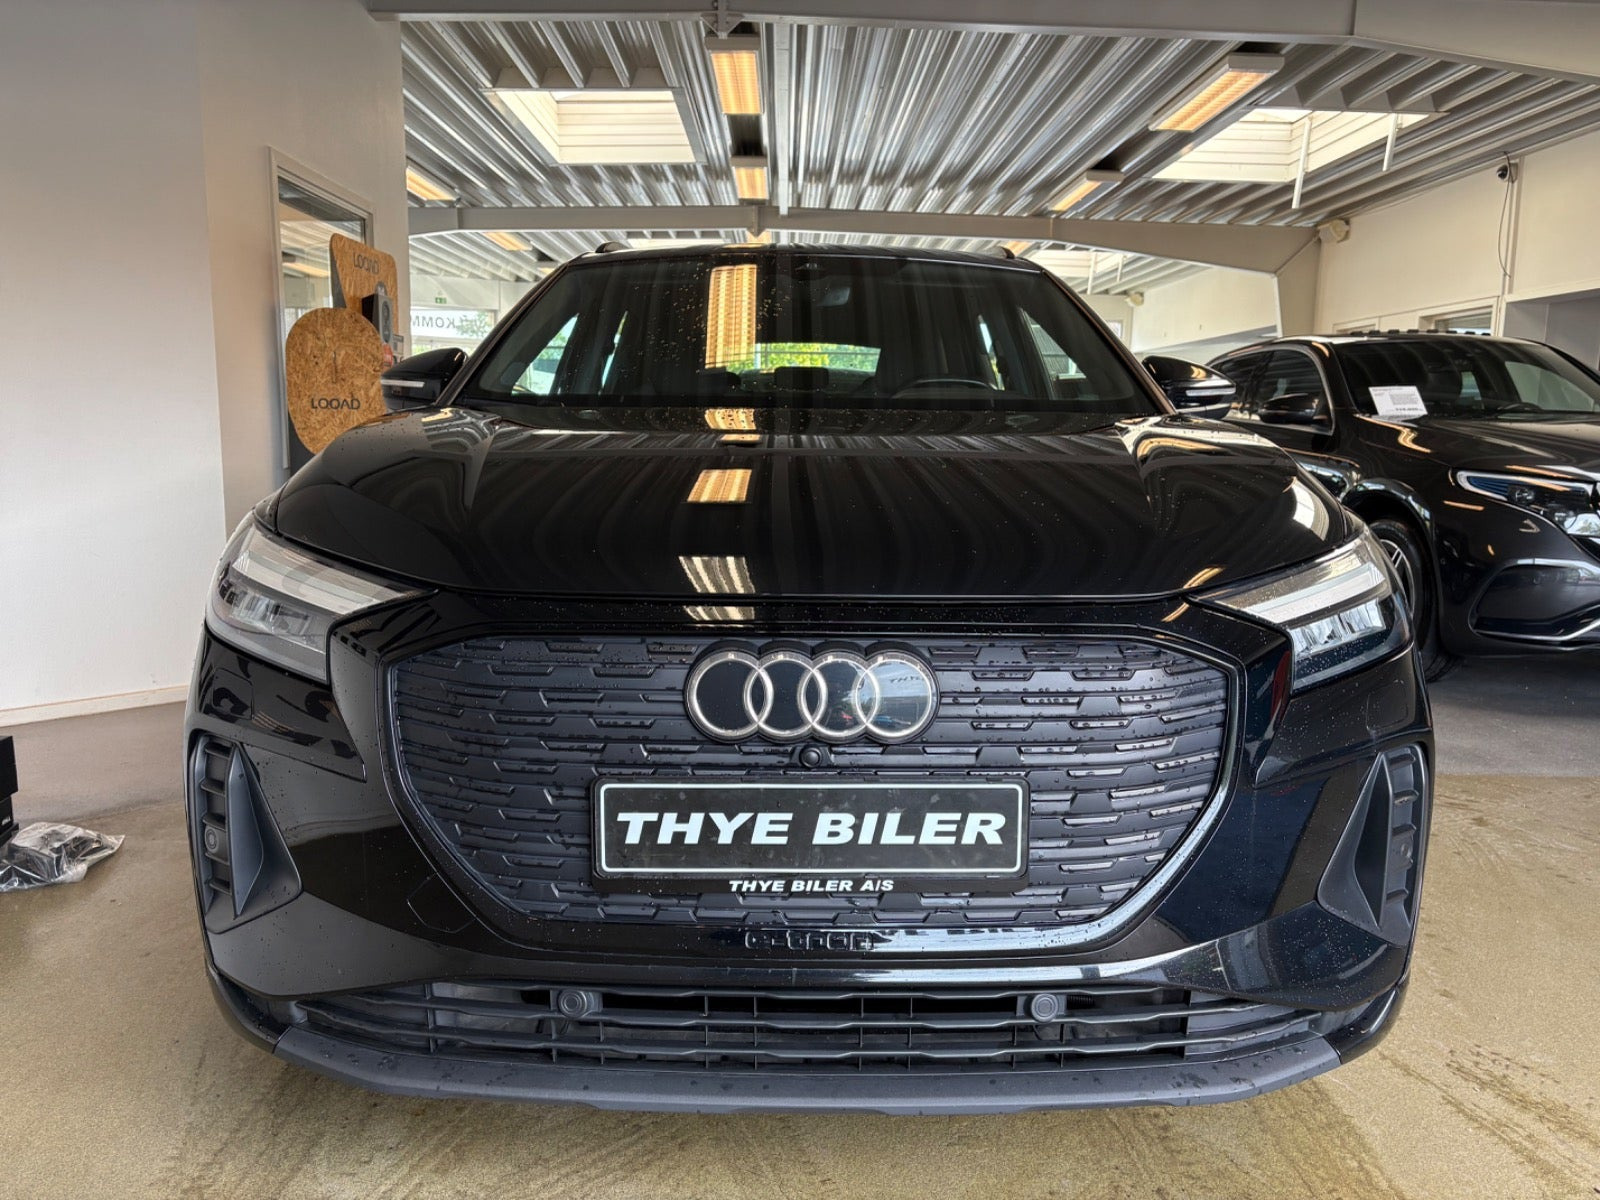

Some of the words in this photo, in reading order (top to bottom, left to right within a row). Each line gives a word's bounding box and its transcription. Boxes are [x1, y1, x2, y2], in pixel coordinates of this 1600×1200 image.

[311, 398, 361, 410] LOOAD
[616, 812, 794, 845] THYE
[812, 812, 1007, 845] BILER
[728, 879, 786, 892] THYE
[790, 879, 854, 892] BILER
[859, 879, 895, 892] A/S
